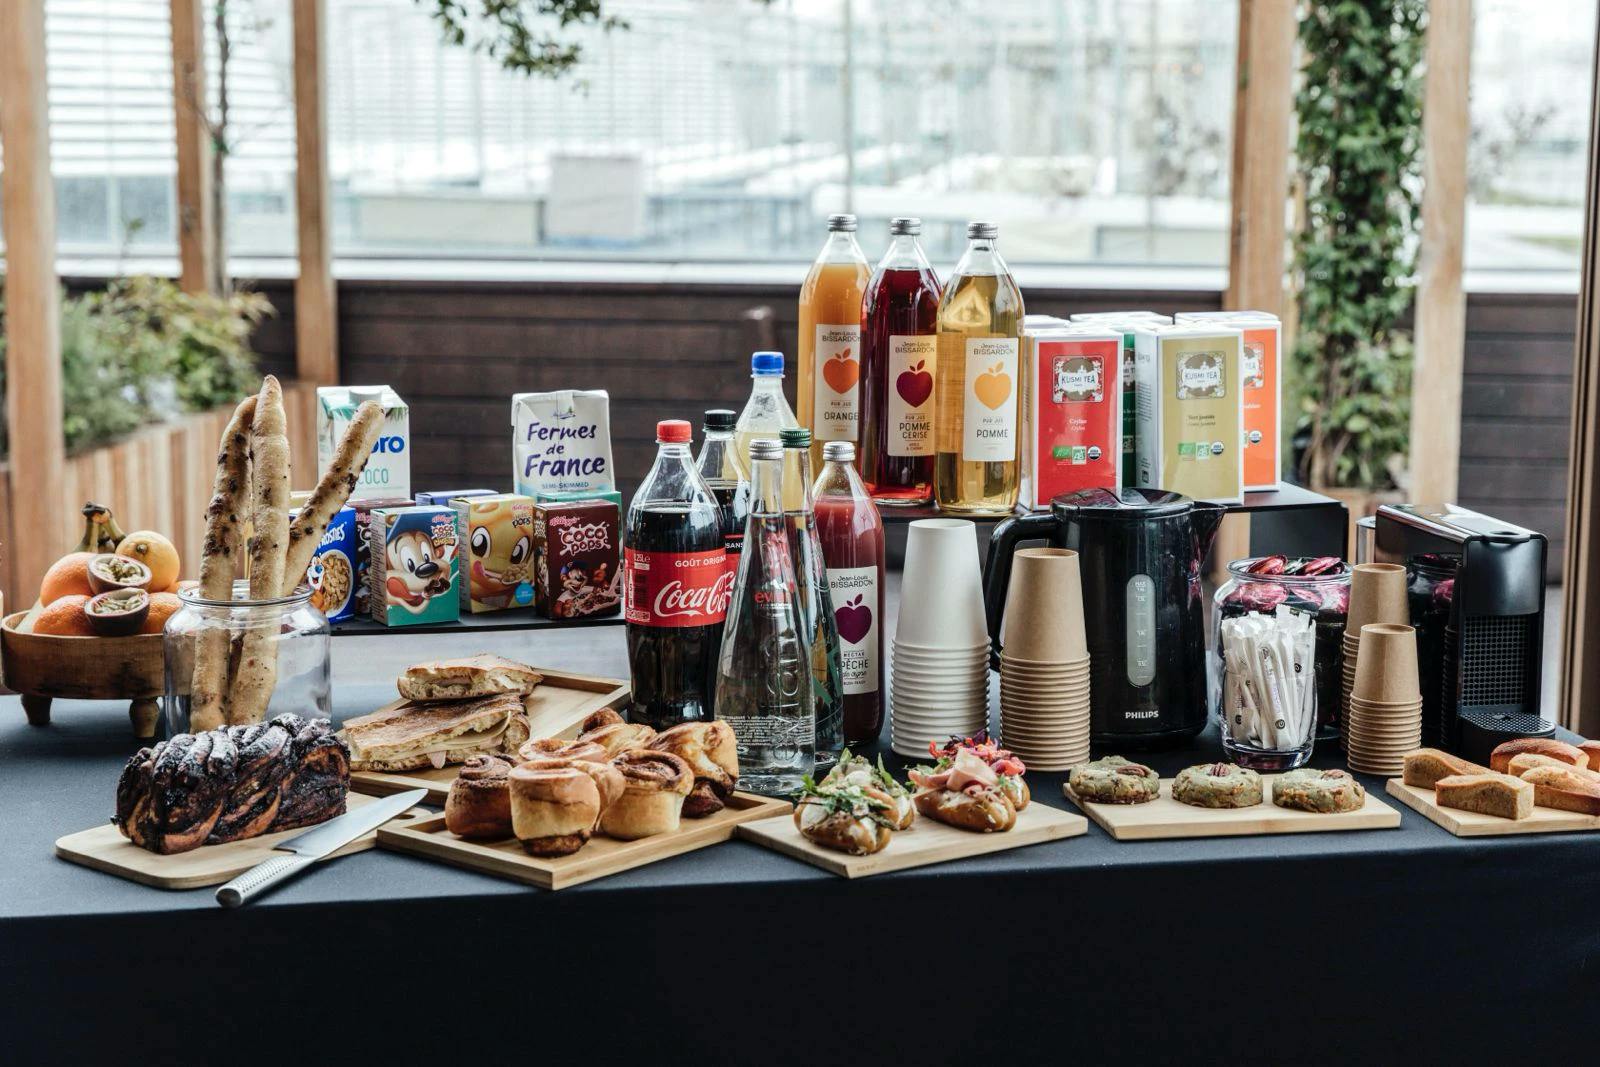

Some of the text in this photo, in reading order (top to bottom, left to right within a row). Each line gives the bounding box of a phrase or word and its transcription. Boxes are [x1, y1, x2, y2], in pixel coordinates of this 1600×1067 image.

[1184, 371, 1205, 379] KUSMI
[1061, 376, 1082, 384] KUSMI
[899, 422, 931, 431] POMME
[527, 422, 597, 441] Fermes
[902, 431, 928, 439] CERISE
[976, 429, 1008, 438] POMME
[546, 444, 565, 455] de
[525, 454, 605, 477] France
[674, 558, 702, 568] GOÛT
[830, 580, 873, 588] BISSARDON
[841, 657, 868, 670] PÊCHE
[1125, 710, 1159, 719] PHILIPS
